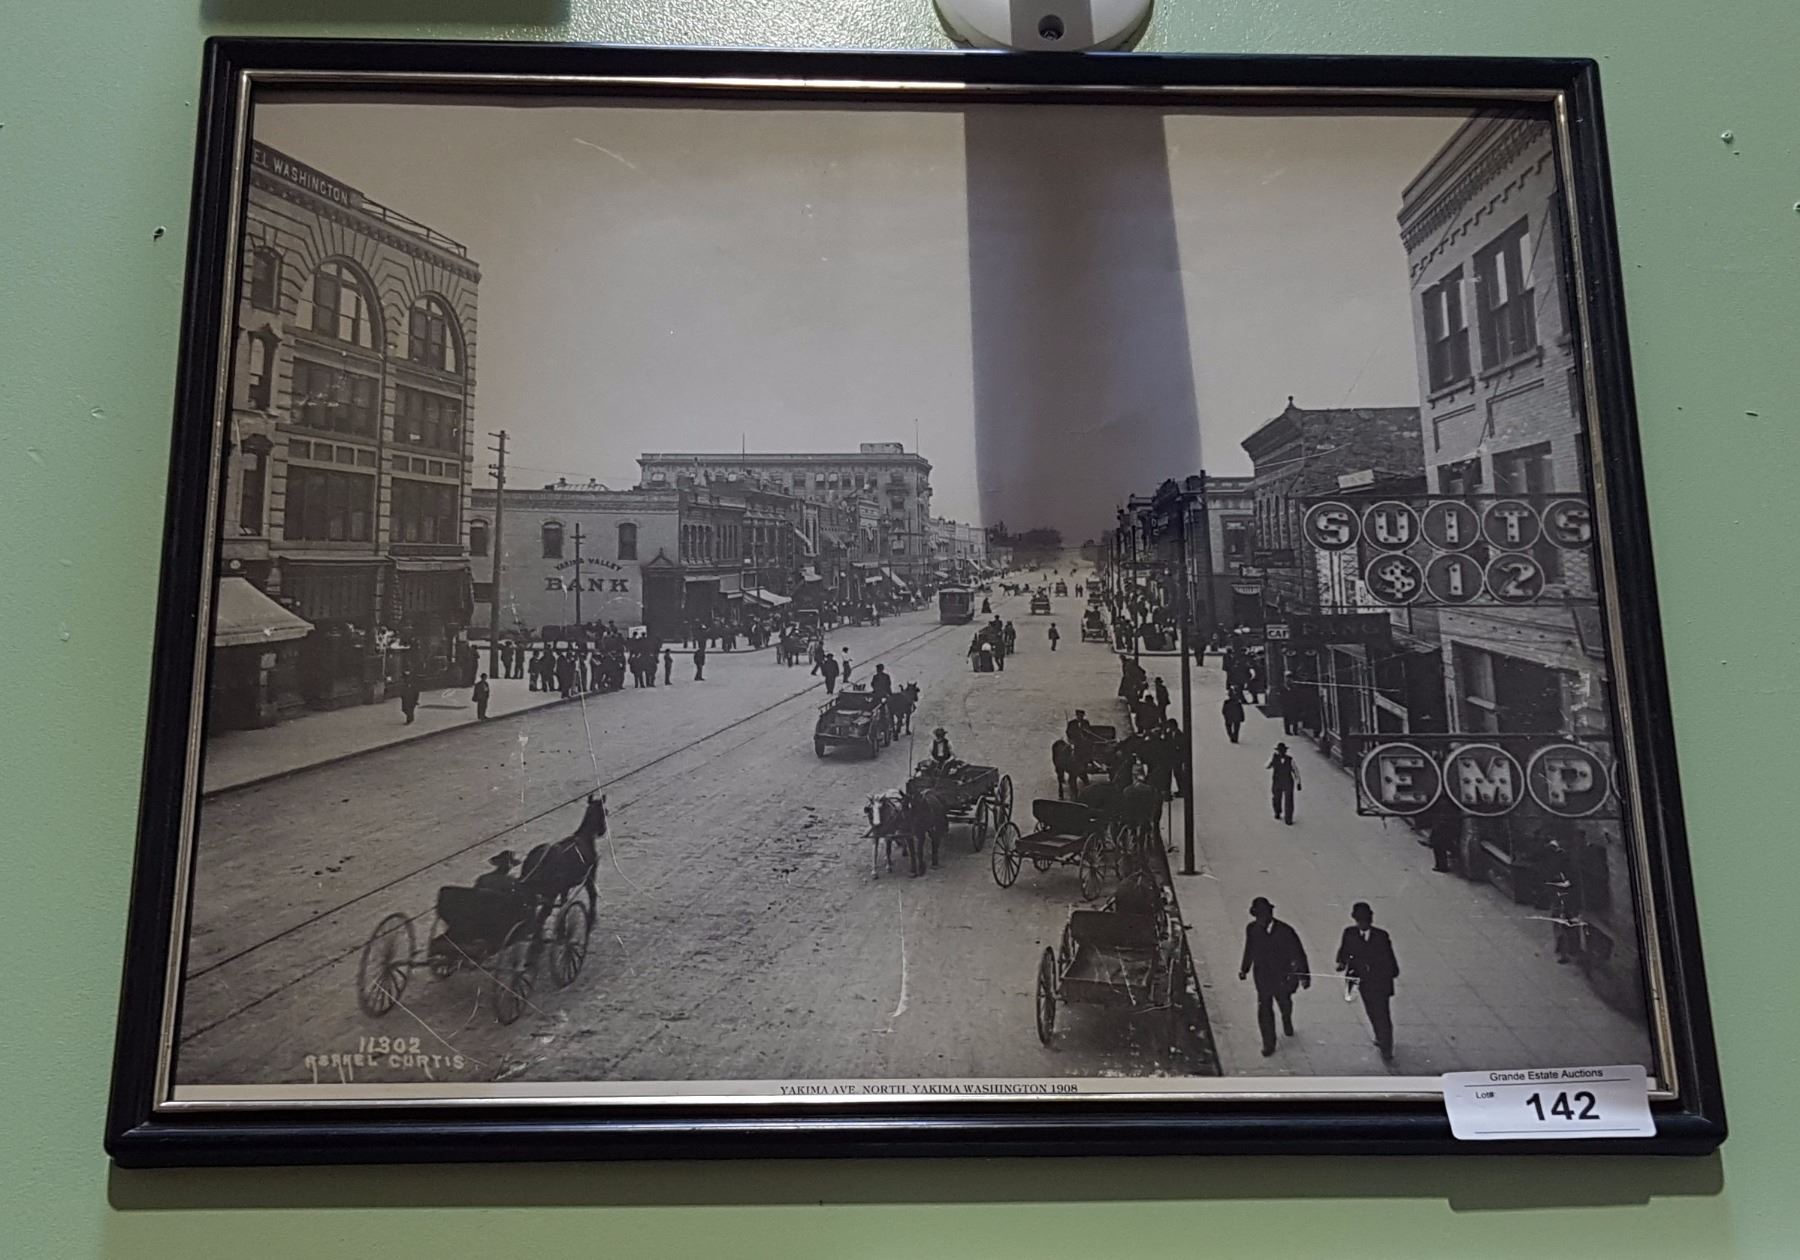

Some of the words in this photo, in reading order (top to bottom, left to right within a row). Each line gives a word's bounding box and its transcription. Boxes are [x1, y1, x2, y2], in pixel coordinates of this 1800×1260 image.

[273, 157, 349, 205] WASHINGTON
[1316, 509, 1592, 544] SUITS
[588, 558, 623, 571] VALLEY
[544, 577, 629, 592] BANK
[1378, 561, 1535, 598] $12
[359, 1036, 421, 1054] 11302
[388, 1054, 465, 1080] CURTIS
[1489, 1072, 1526, 1082] Grande
[1527, 1070, 1559, 1081] Estate
[1561, 1068, 1604, 1079] Auctions
[780, 1085, 828, 1096] YAKIMA
[912, 1084, 960, 1095] YAKIMA
[962, 1084, 1048, 1094] WASHINGTON
[1051, 1084, 1078, 1094] 1908
[1525, 1090, 1601, 1122] 142
